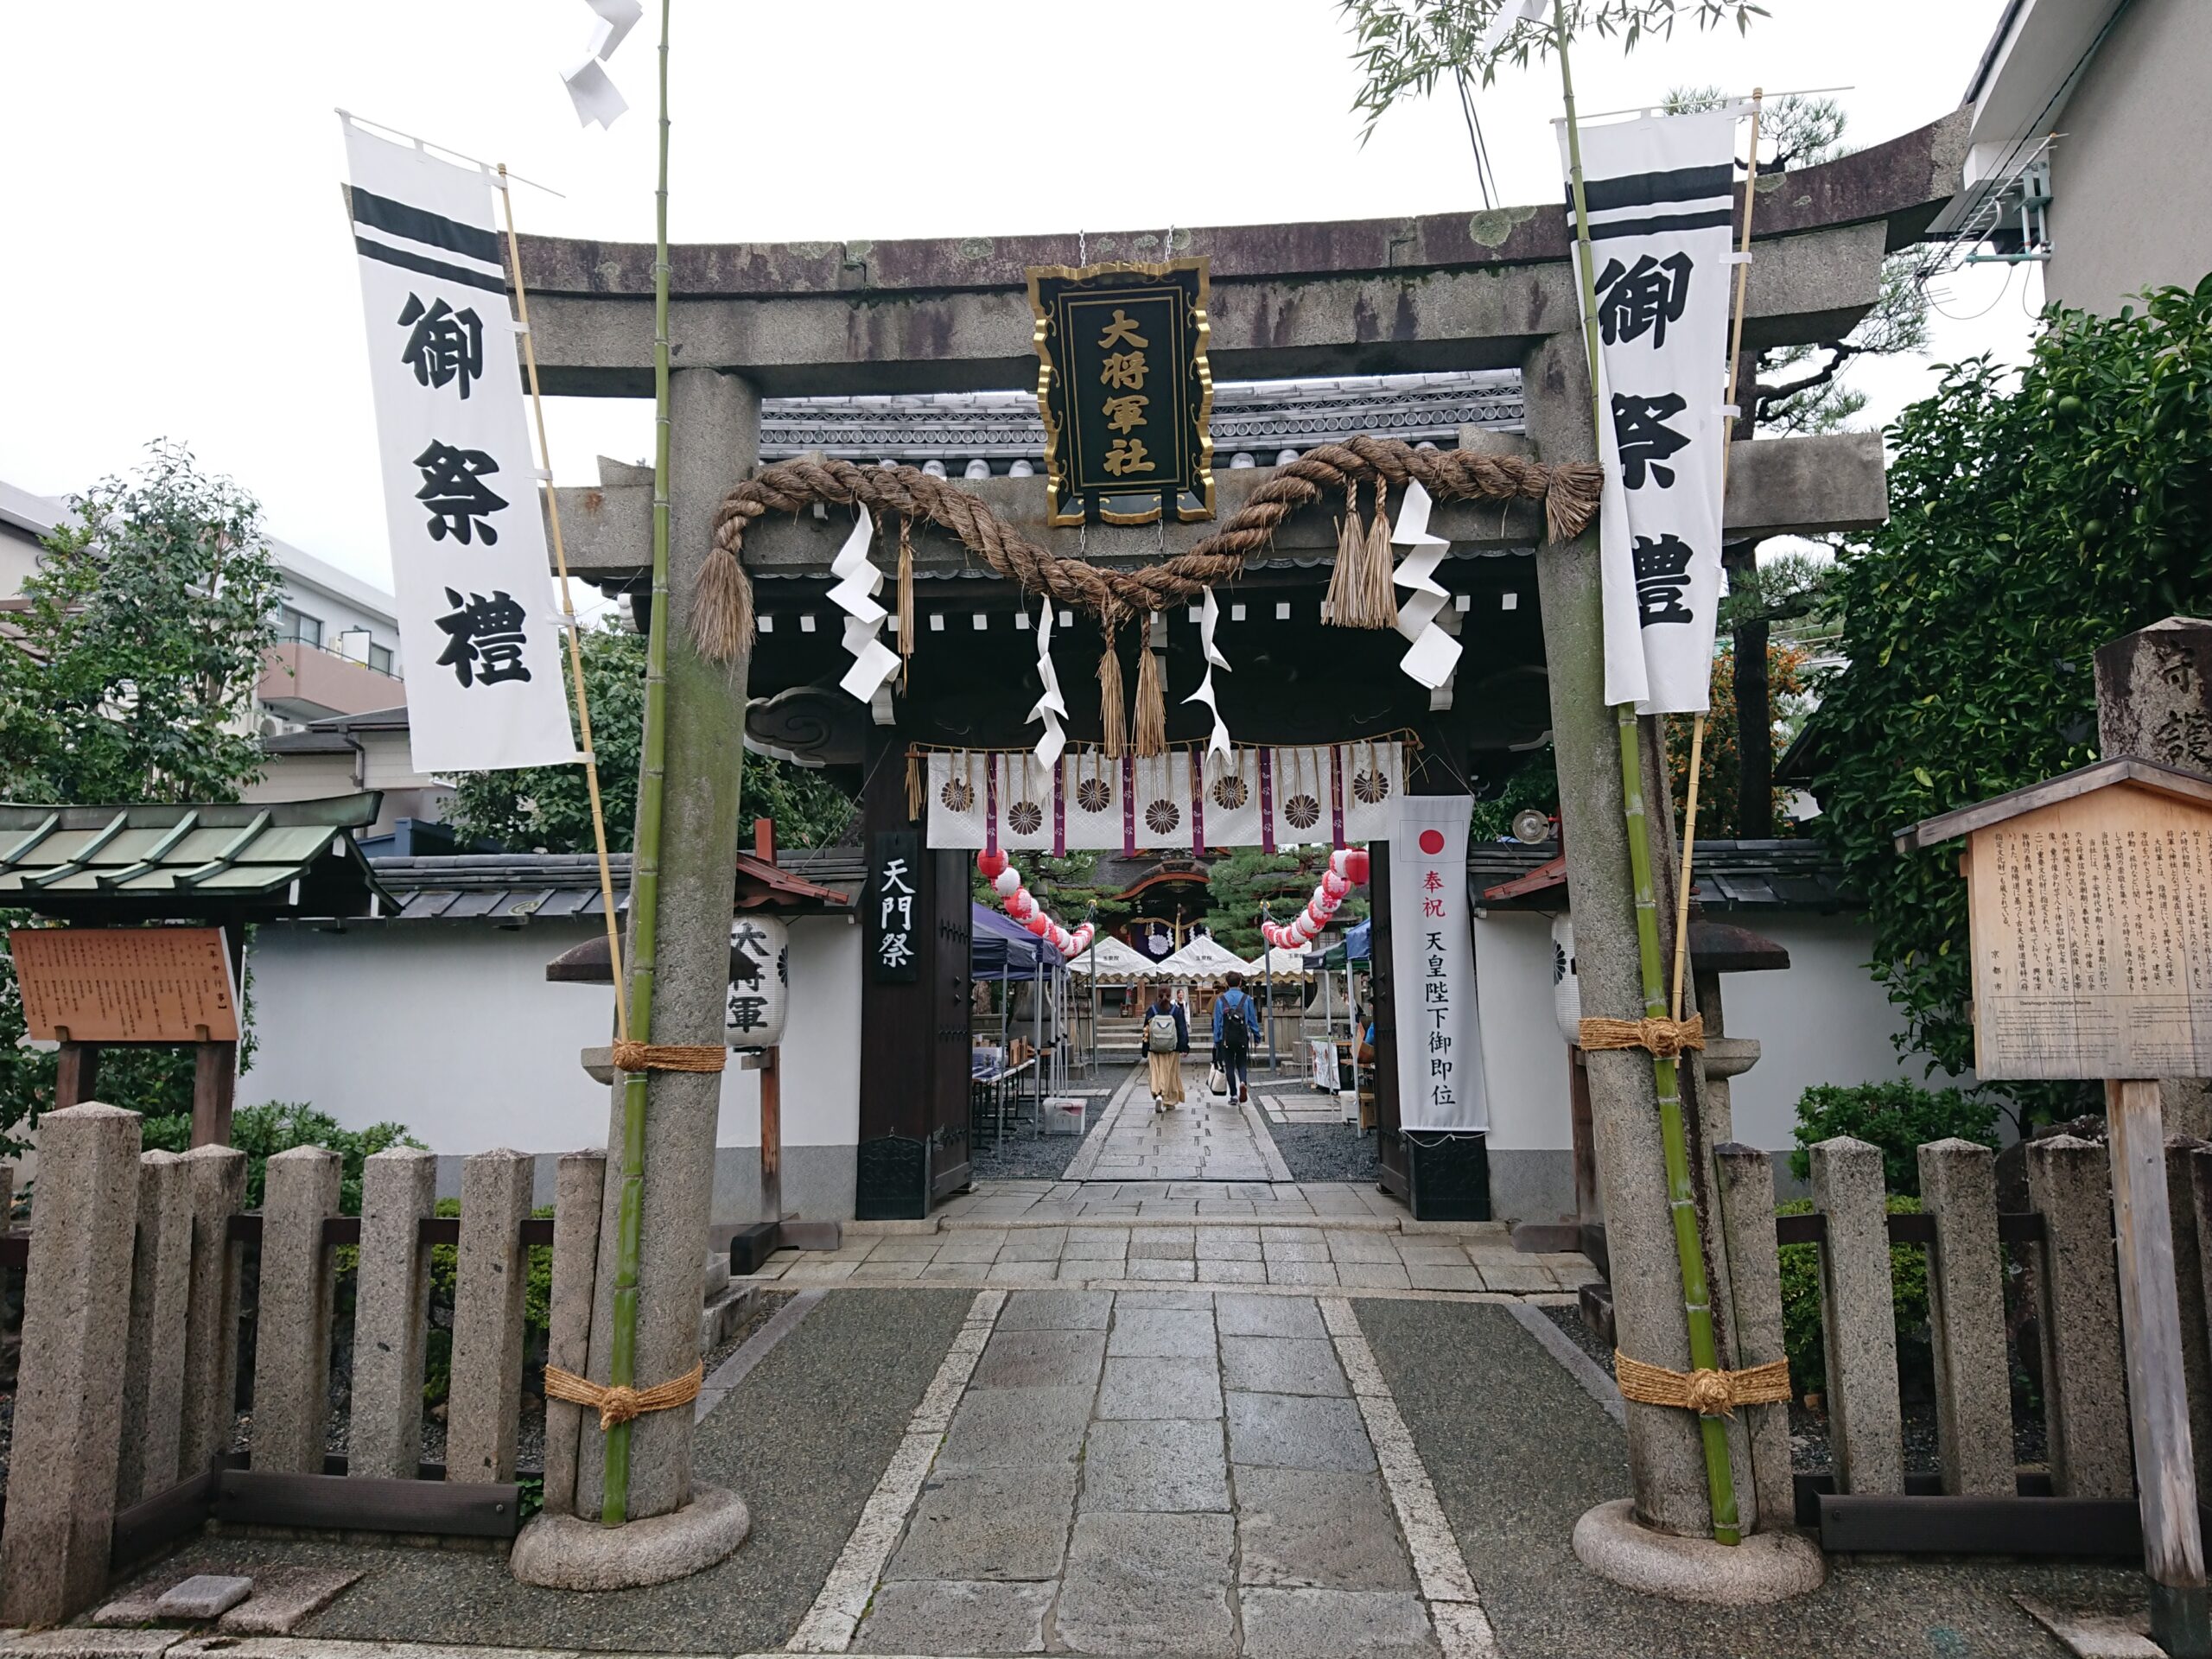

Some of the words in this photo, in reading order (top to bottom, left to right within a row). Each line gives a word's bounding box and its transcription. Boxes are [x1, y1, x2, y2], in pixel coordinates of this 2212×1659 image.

[397, 291, 533, 688] 御祭禮
[879, 858, 916, 969] 天門祭
[1421, 870, 1446, 918] 奉祝
[1424, 931, 1456, 1107] 天皇陛下御即位
